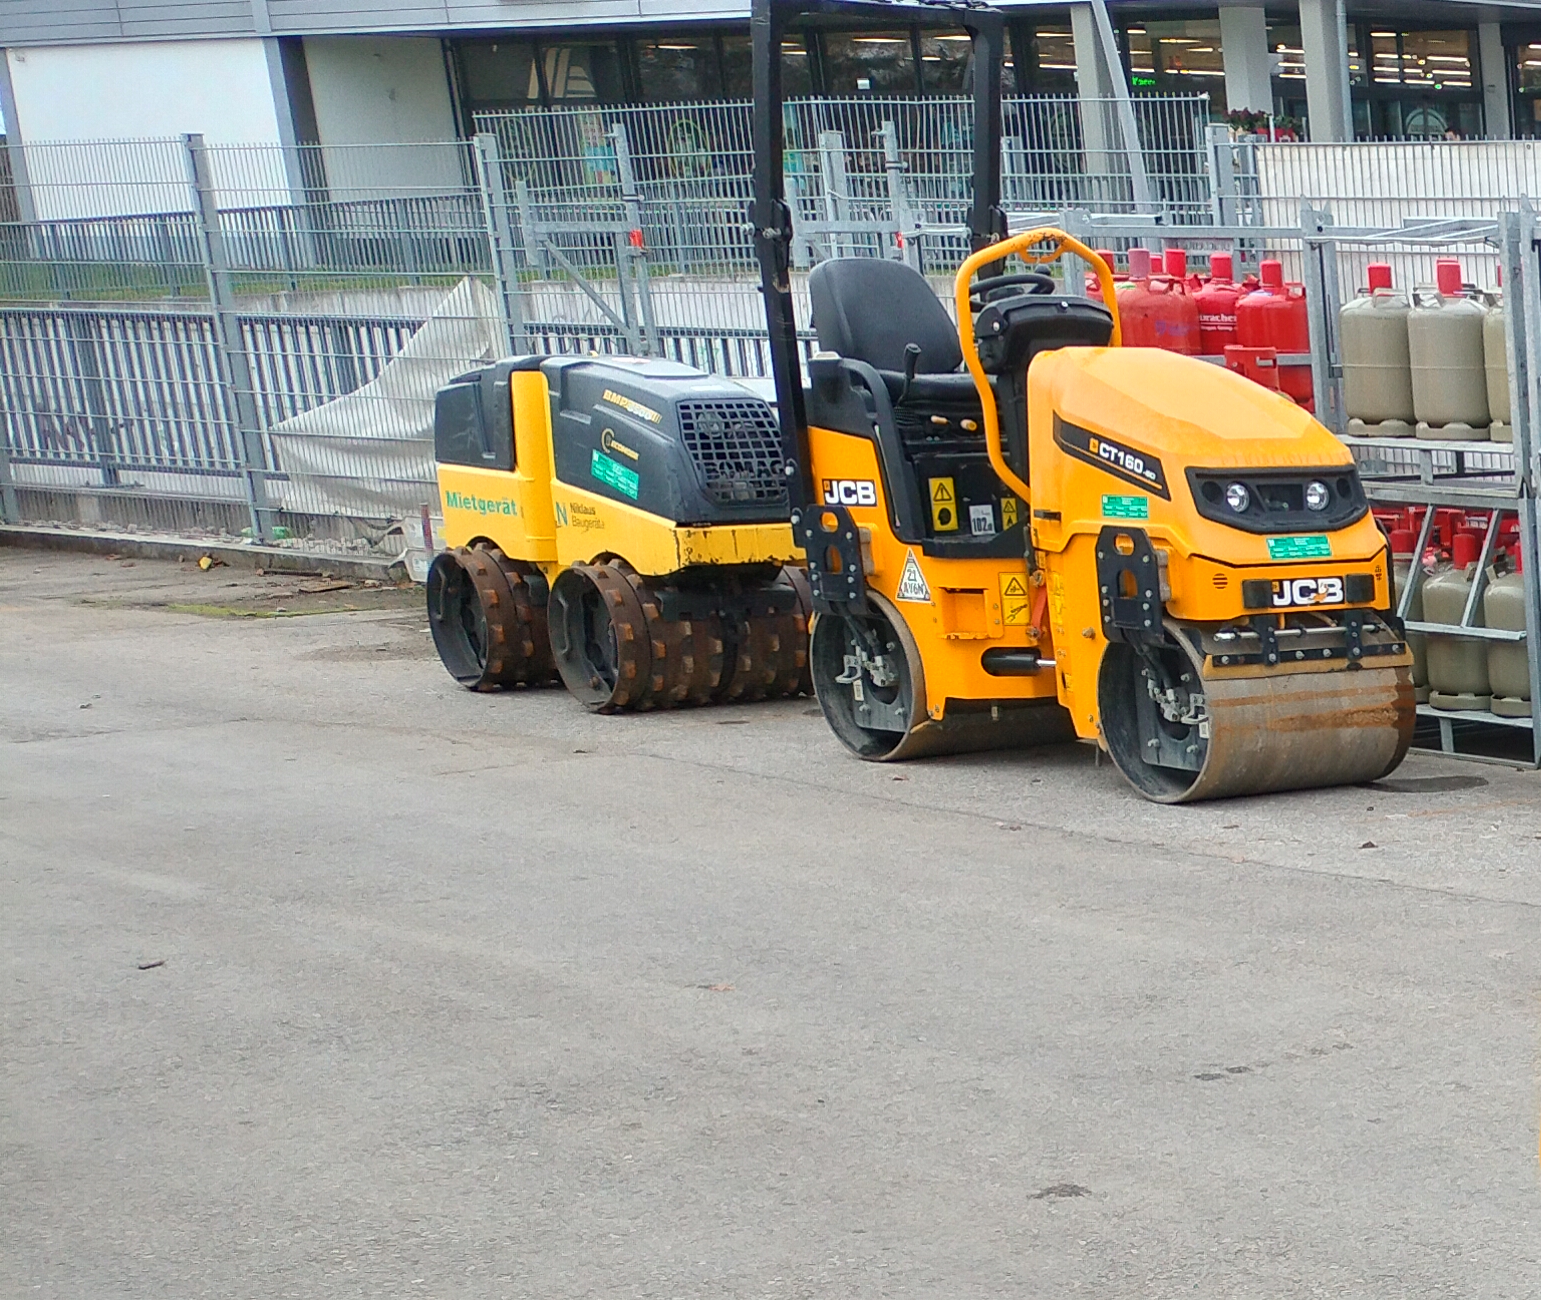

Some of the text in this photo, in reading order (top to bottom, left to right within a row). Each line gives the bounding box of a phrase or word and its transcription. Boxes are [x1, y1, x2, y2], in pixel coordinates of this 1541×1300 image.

[446, 490, 518, 516] Mietgerät
[824, 480, 876, 505] JCB
[570, 503, 596, 516] Niklaus
[1273, 577, 1344, 606] JCB
